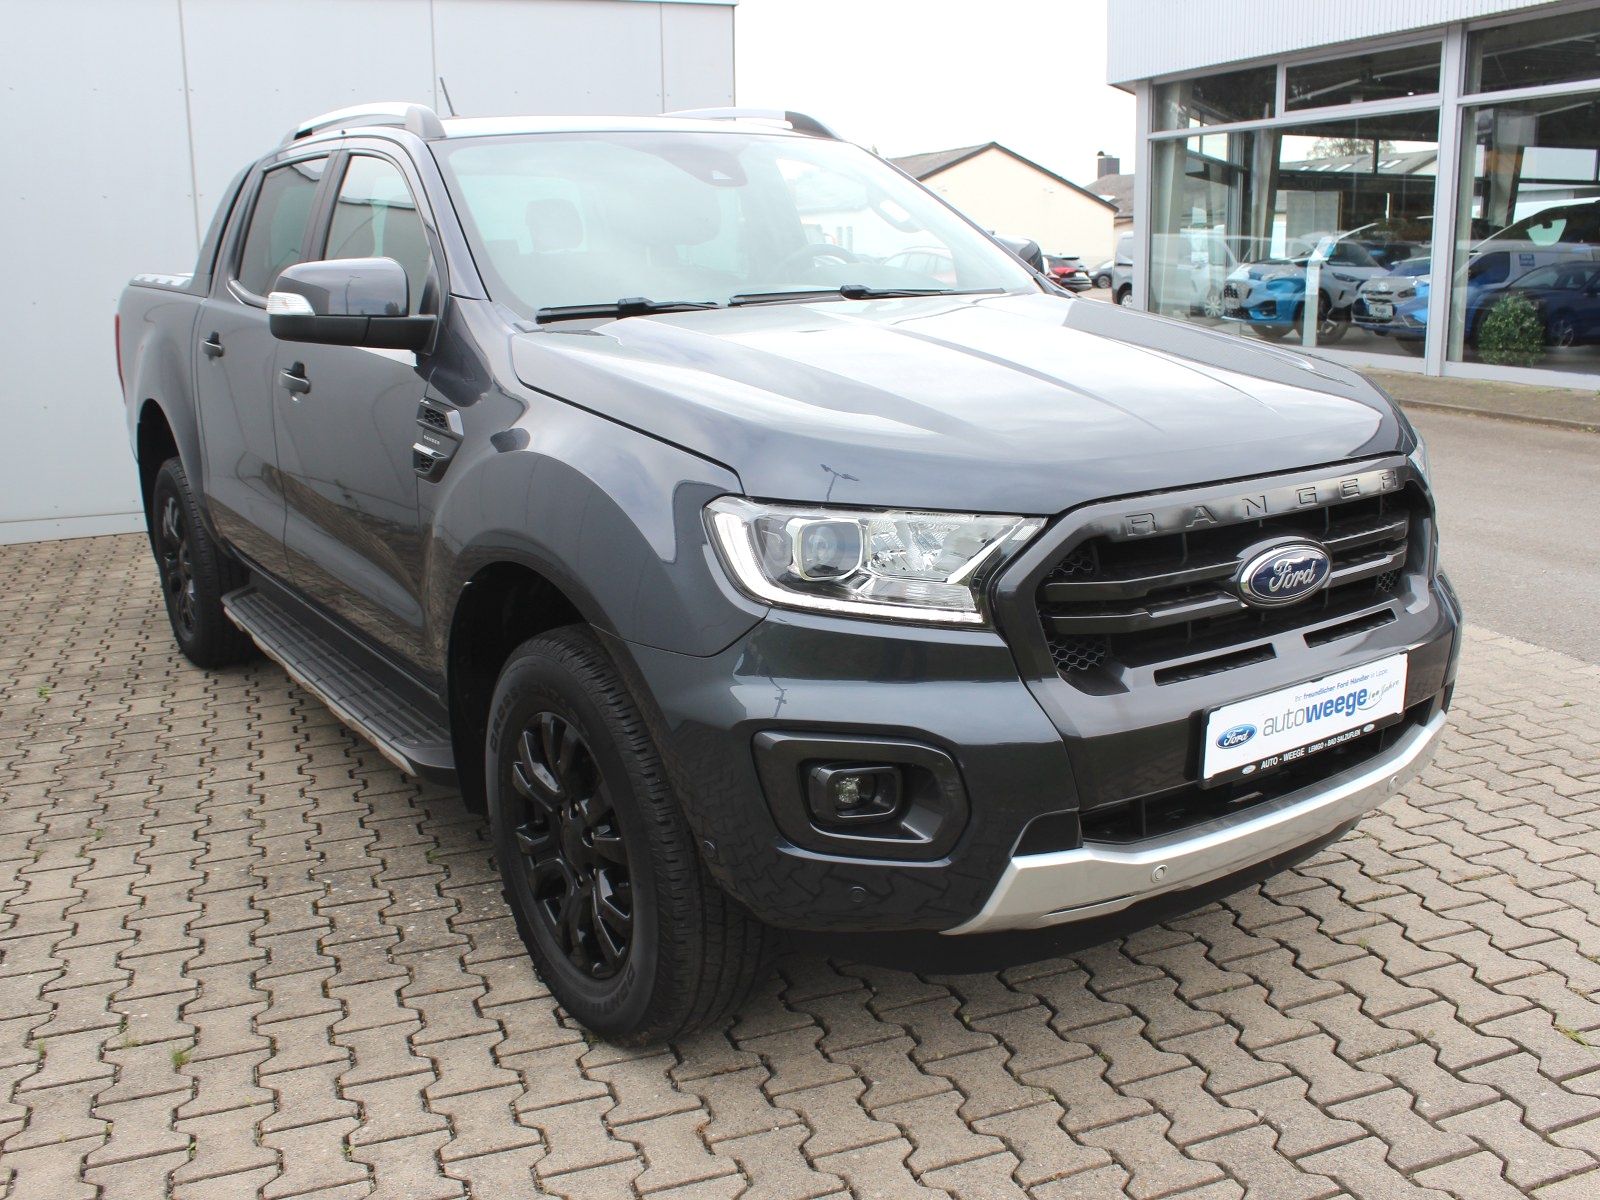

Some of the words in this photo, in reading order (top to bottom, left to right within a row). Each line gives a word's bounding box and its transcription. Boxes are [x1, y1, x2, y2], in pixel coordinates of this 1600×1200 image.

[1125, 469, 1398, 537] RANGER
[1268, 556, 1316, 592] Ford
[1337, 680, 1349, 689] Ford
[1263, 688, 1367, 736] autoweege
[1223, 728, 1250, 746] Ford
[1260, 756, 1278, 769] AUTO
[1283, 747, 1306, 762] WEEGE
[1308, 742, 1324, 753] LEMGO
[1327, 737, 1337, 747] BAD
